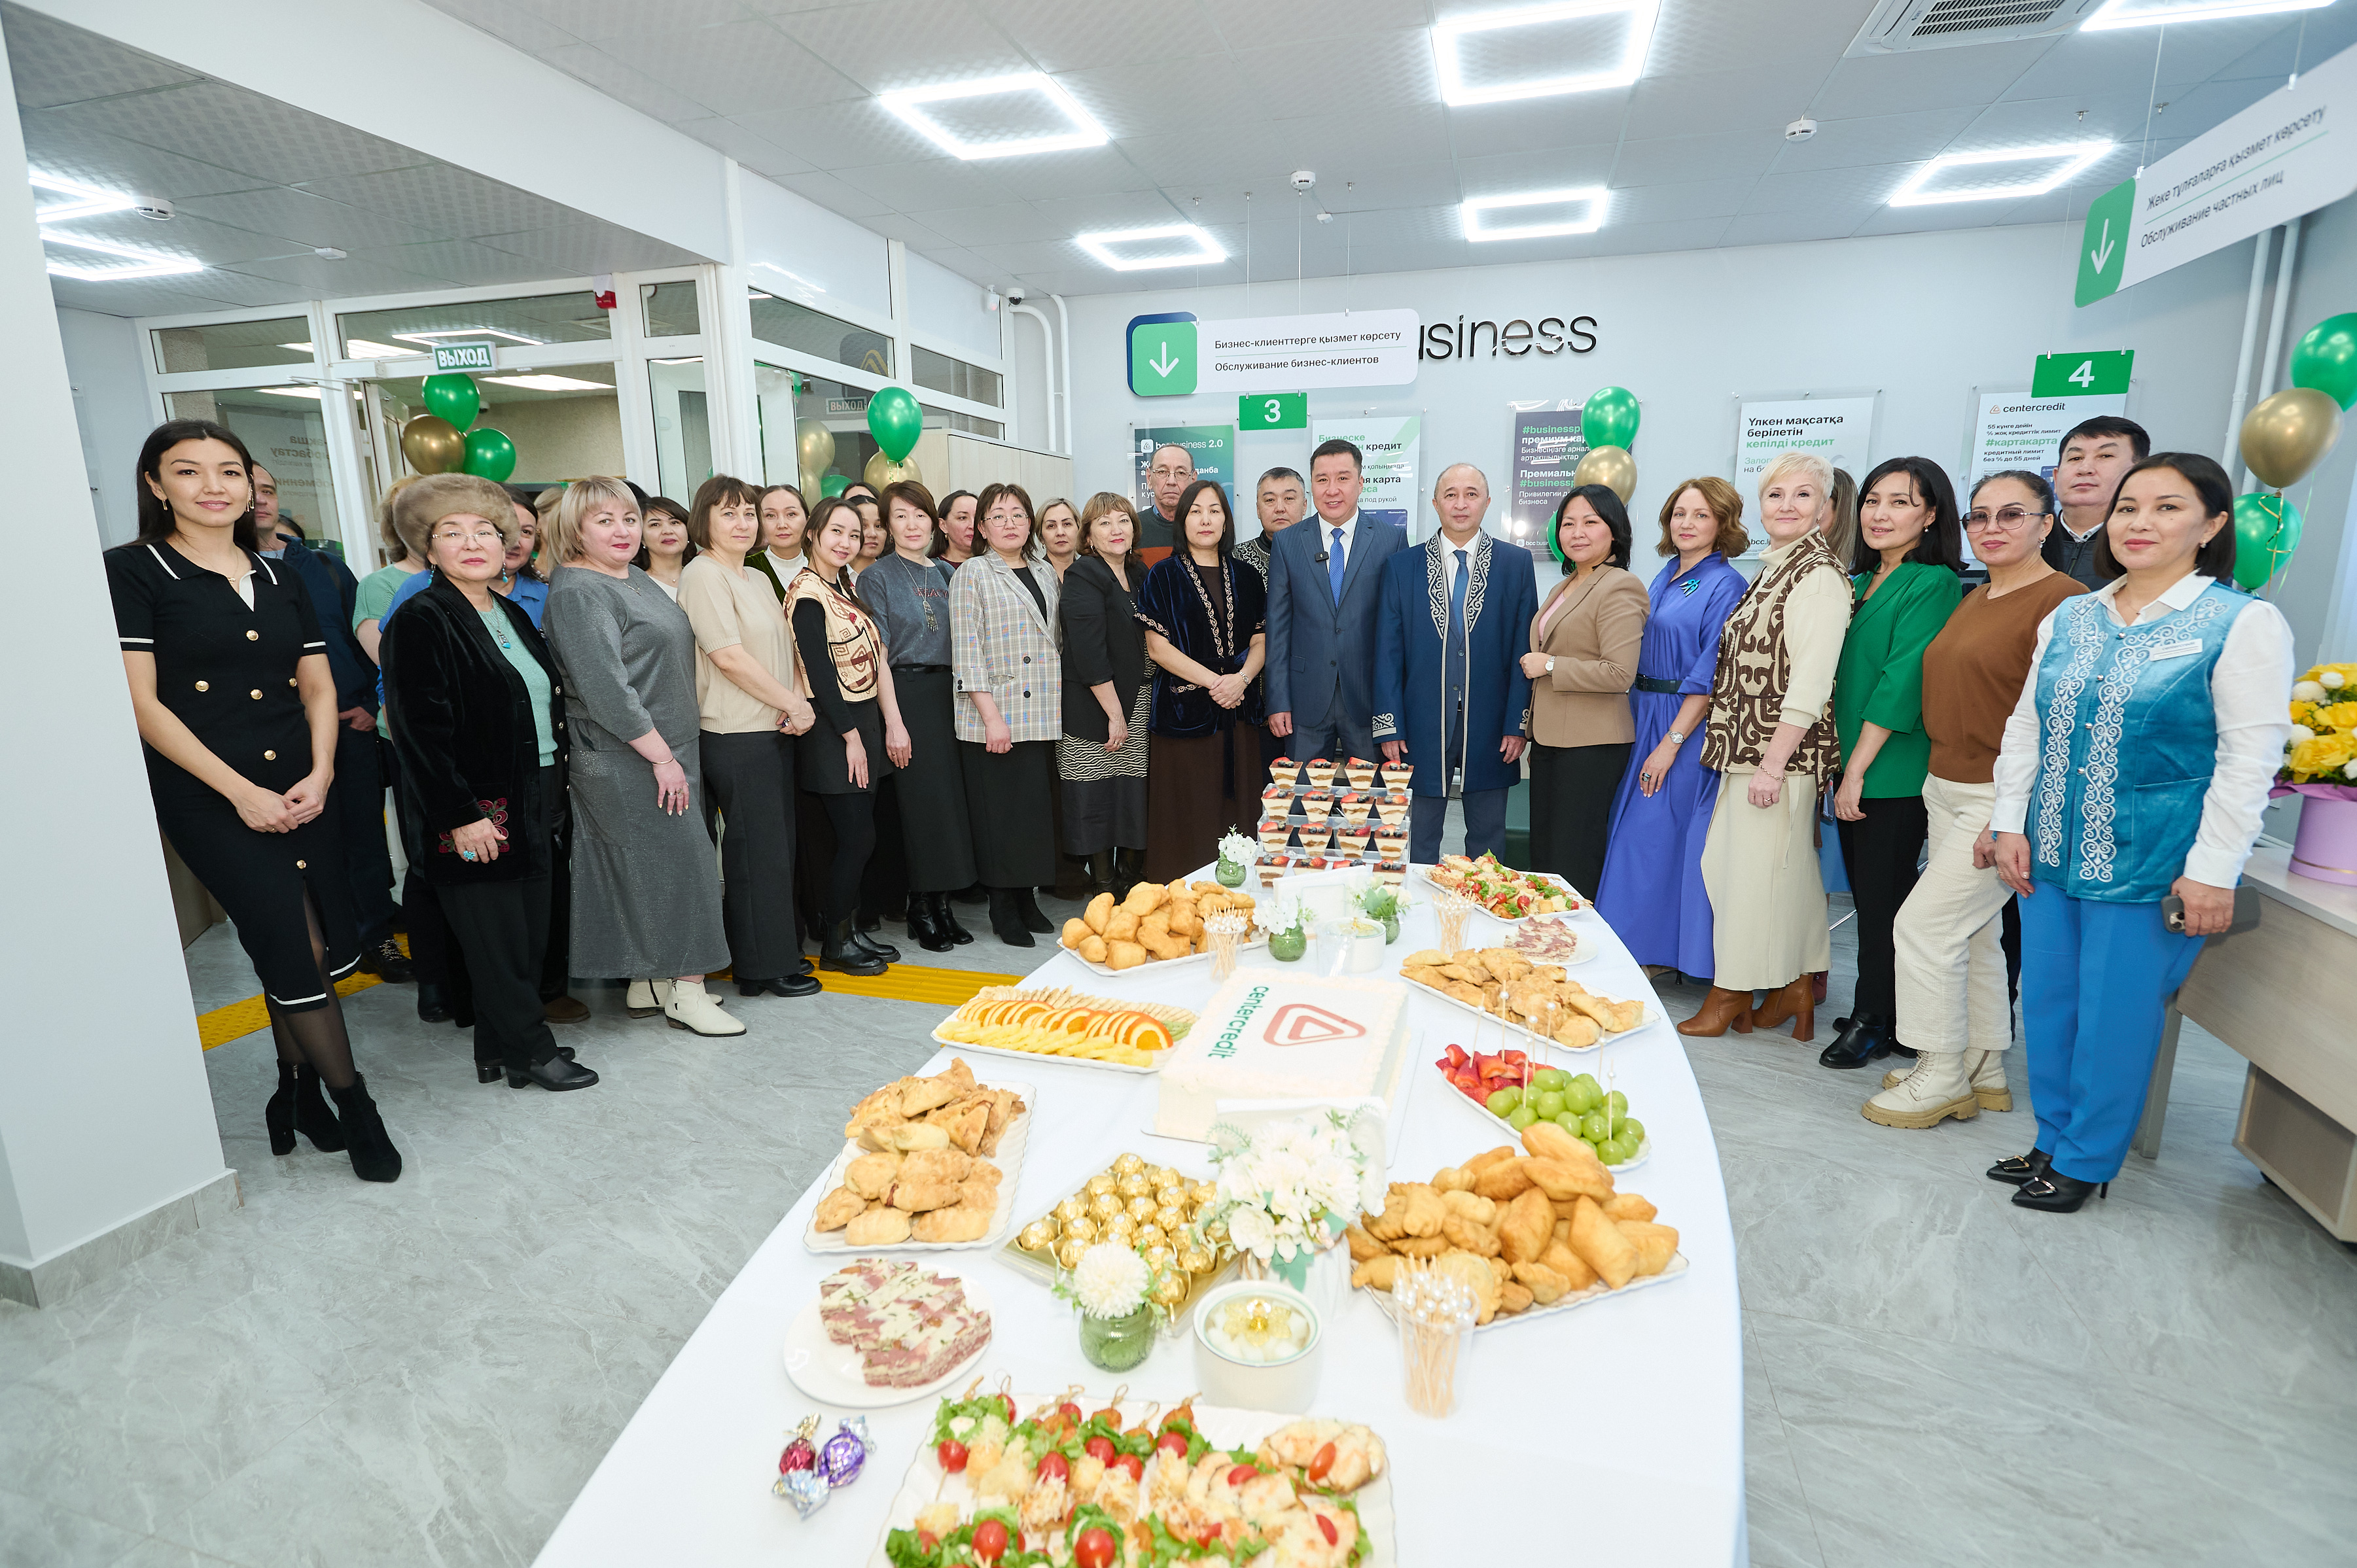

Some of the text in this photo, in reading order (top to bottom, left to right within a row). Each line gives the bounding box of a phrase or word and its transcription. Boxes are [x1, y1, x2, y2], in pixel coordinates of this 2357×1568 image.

[2147, 105, 2326, 211] Жеке тұлғаларға қызмет көрсету
[2141, 170, 2284, 248] Обслуживание частных лиц
[1215, 332, 1401, 349] Бизнес-клиенттерге қызмет көрсету
[437, 347, 490, 367] ВЫХОД
[1215, 356, 1379, 372] Обслуживание бизнес-клиентов
[2068, 360, 2095, 387] 4
[830, 401, 863, 411] ВЫХОД
[1264, 399, 1281, 423] 3
[2003, 403, 2065, 412] centercredit
[1786, 416, 1843, 425] мақсатқа
[1523, 425, 1582, 434] #businessp
[1747, 428, 1803, 438] берілетін
[1209, 439, 1224, 448] 2.0
[1746, 439, 1834, 448] кепілді кредит
[1985, 438, 2057, 447] #картакарта
[1195, 466, 1218, 475] данба
[1520, 470, 1576, 479] Премиальн
[1207, 986, 1269, 1058] centercredit
